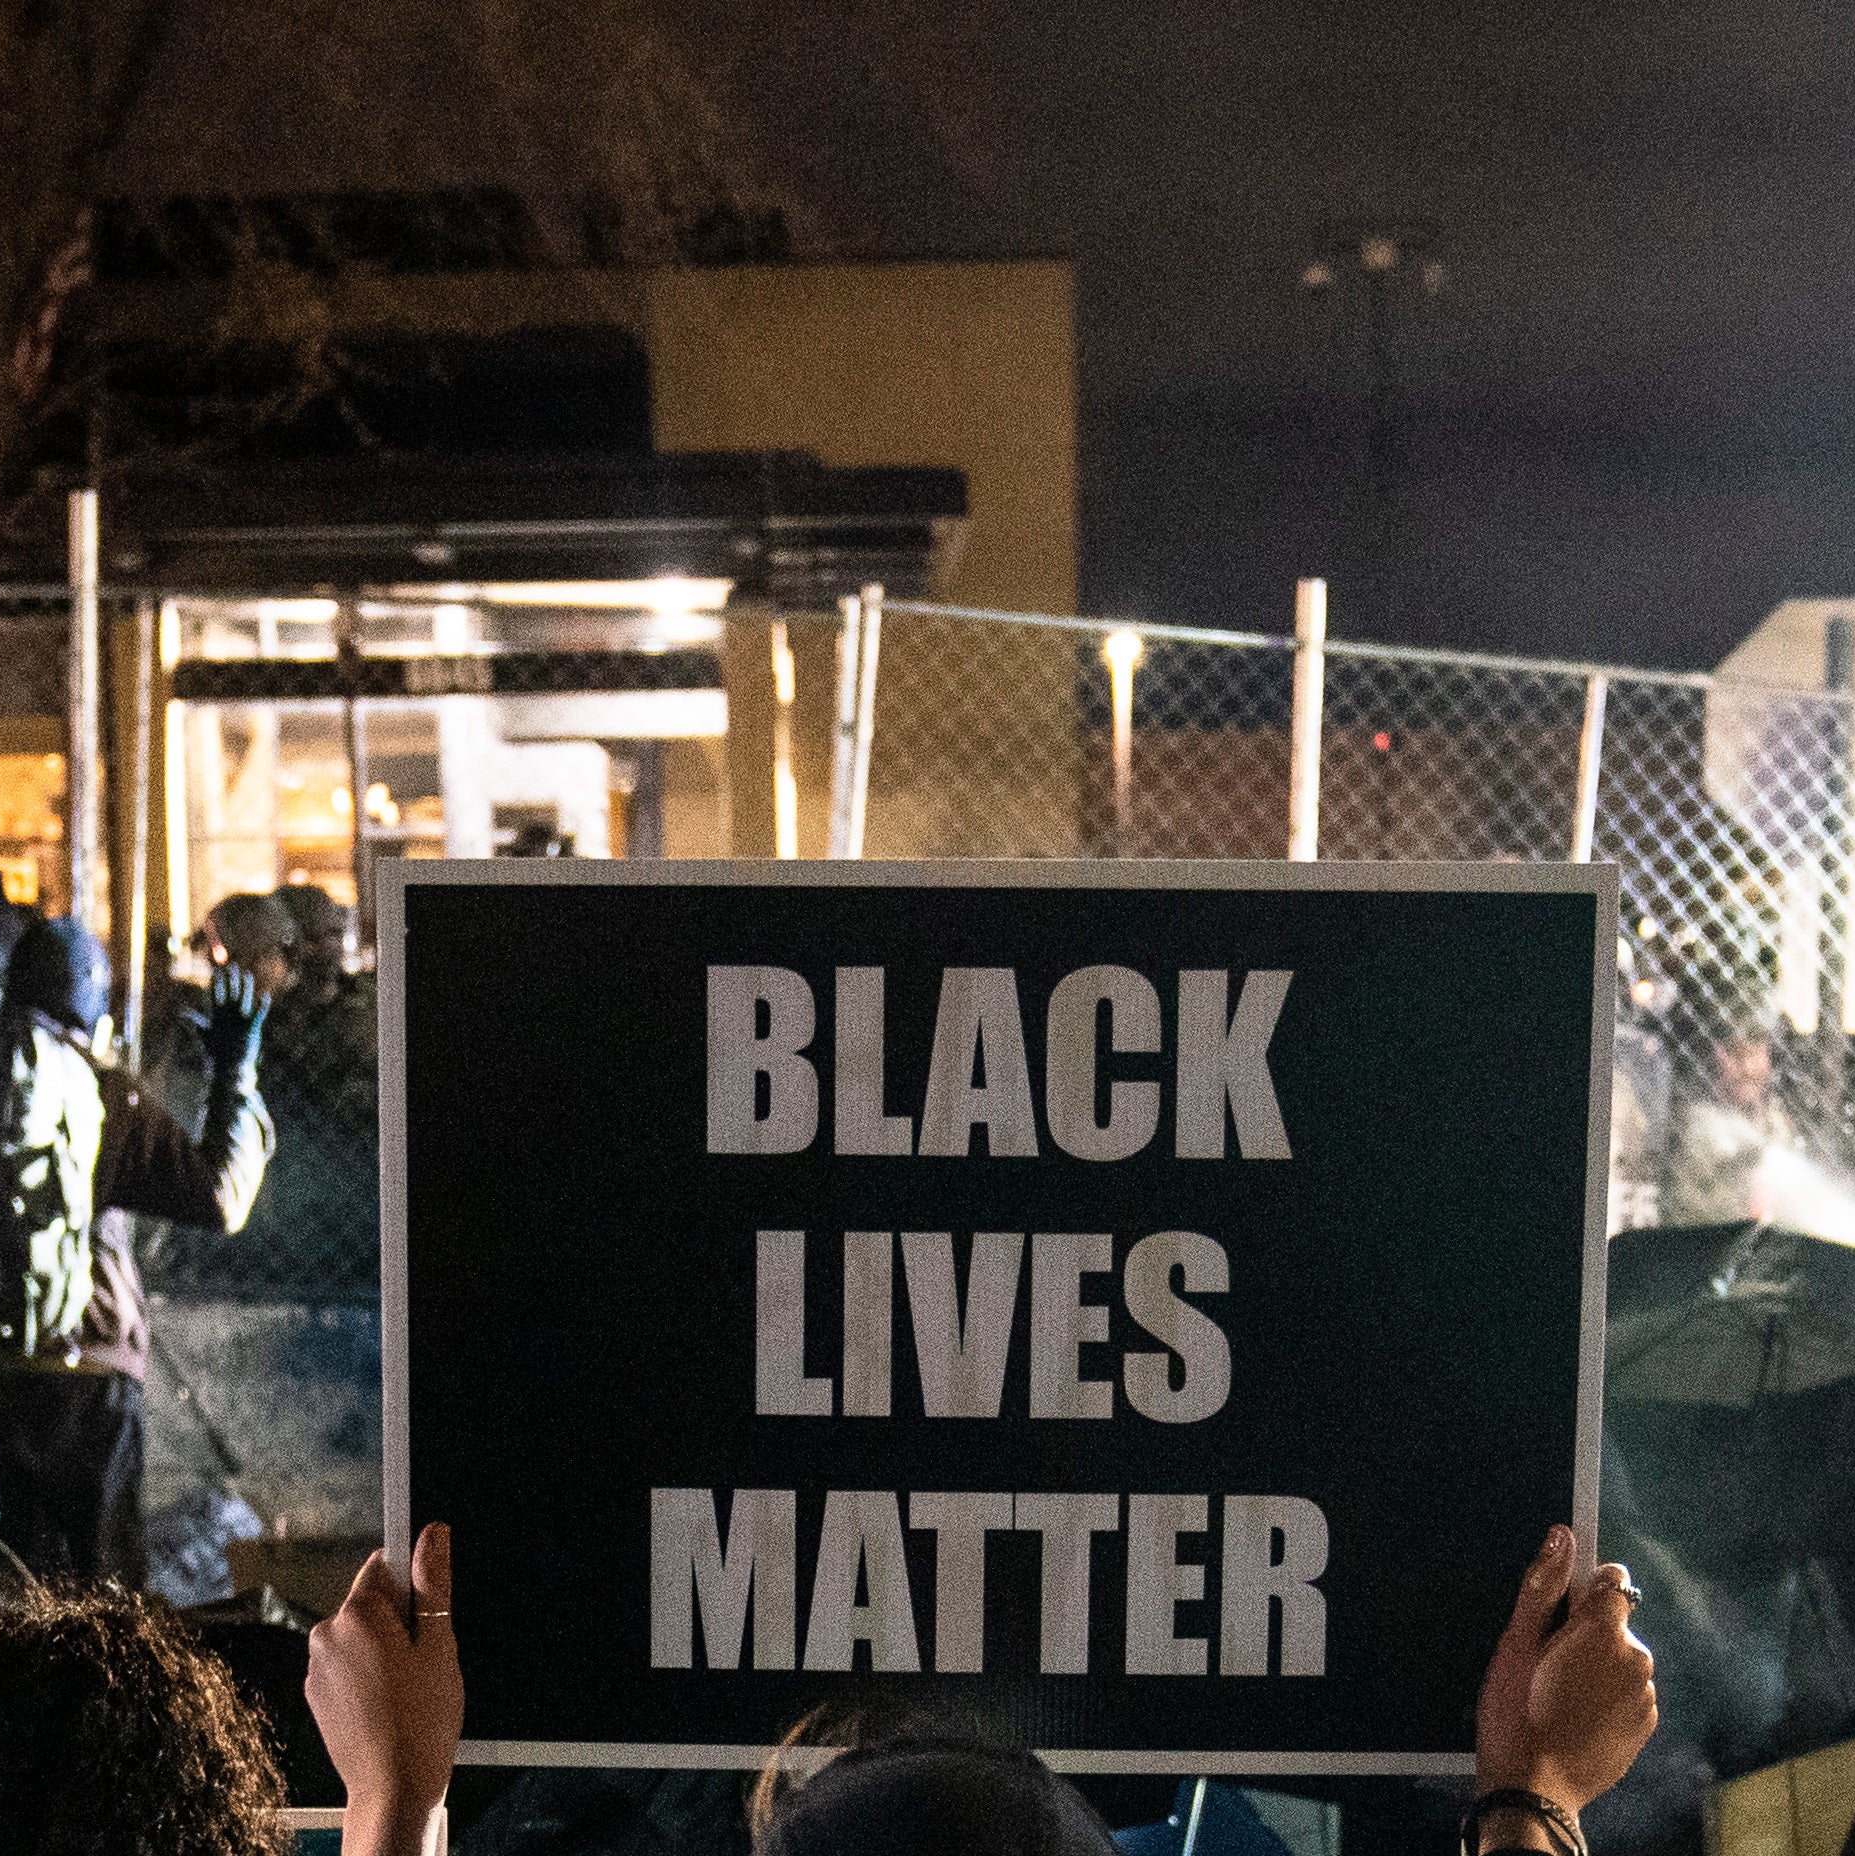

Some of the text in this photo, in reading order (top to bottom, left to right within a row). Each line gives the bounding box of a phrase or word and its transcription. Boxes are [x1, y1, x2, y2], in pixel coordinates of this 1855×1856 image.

[706, 964, 1294, 1162] BLACK
[755, 1230, 1232, 1424] LIVES
[650, 1487, 1330, 1676] MATTER
